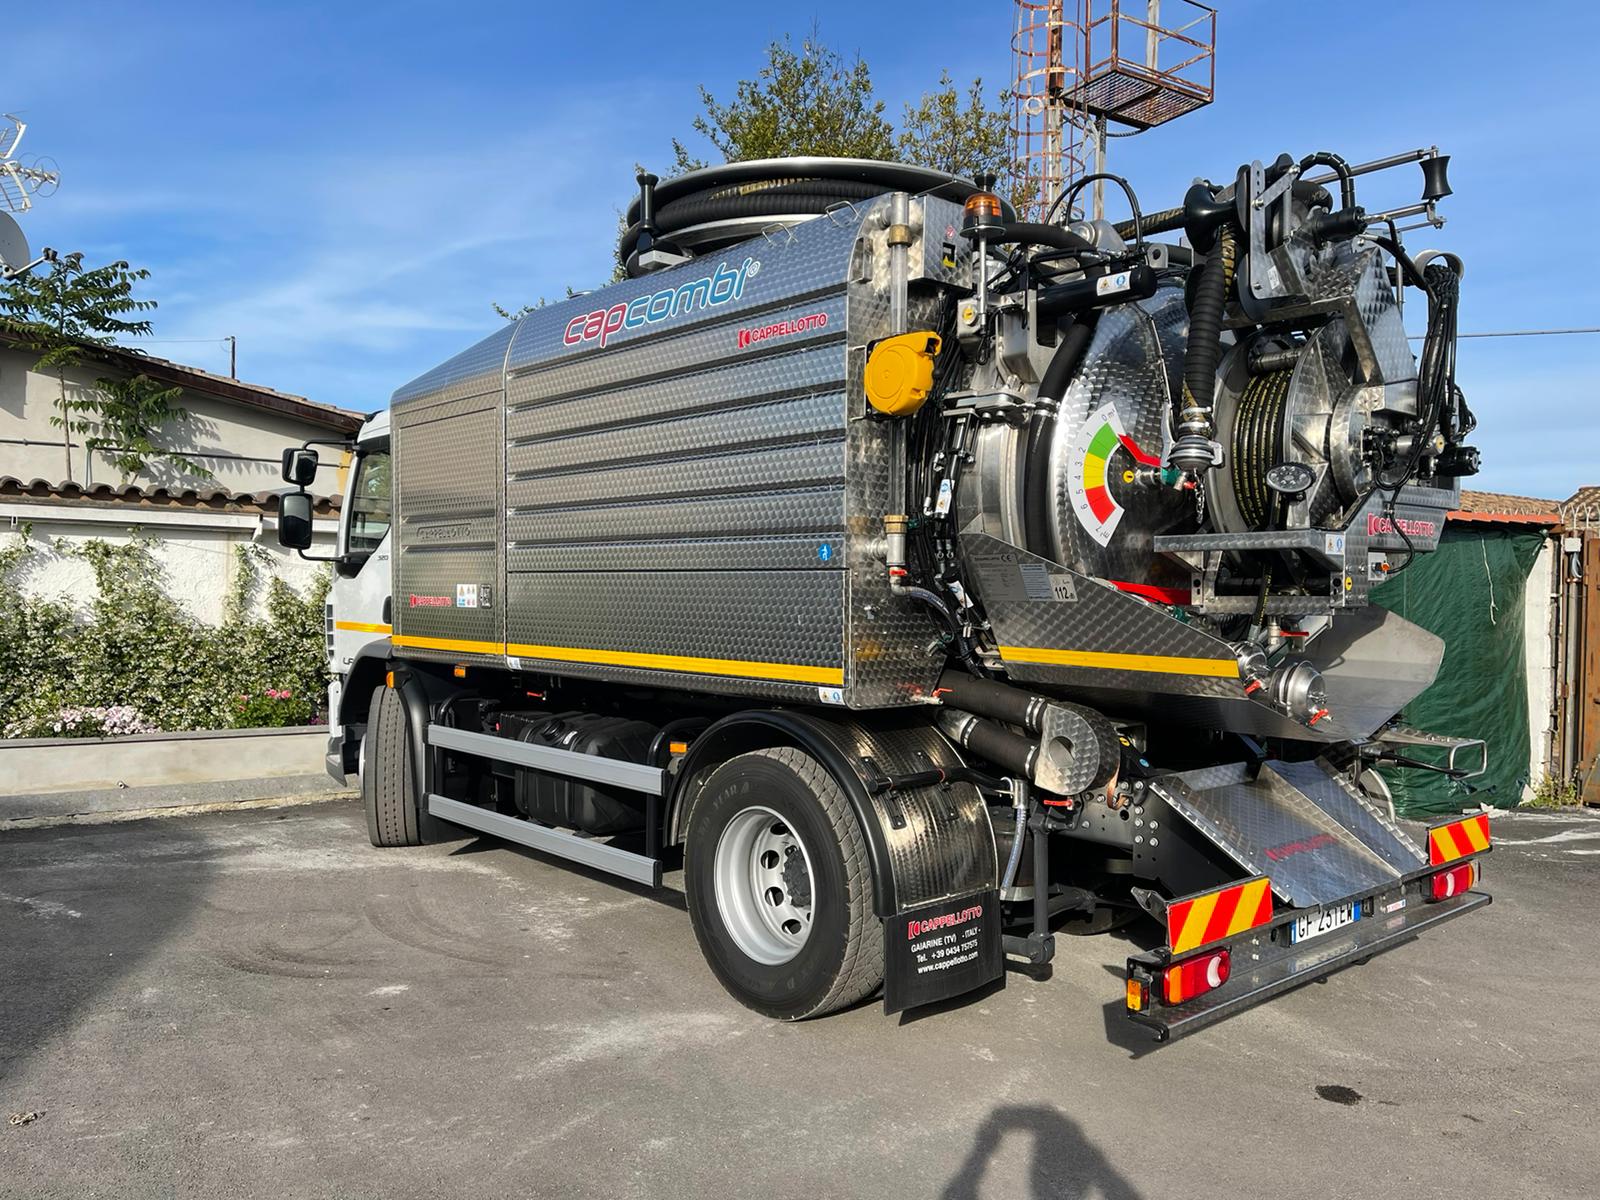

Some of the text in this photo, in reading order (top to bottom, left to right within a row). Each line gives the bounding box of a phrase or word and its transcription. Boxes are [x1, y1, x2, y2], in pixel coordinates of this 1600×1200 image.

[751, 313, 829, 343] CAPPELLOTTO
[1380, 517, 1434, 537] CAPELLOTTO
[1055, 586, 1070, 600] 112
[921, 905, 983, 933] CAPPELLOTTO
[1298, 914, 1312, 938] GF
[911, 937, 943, 953] GAIARINE
[944, 933, 957, 946] (TV)
[916, 938, 978, 963] Tel. +39 0434 757575
[917, 950, 979, 974] www.cappellotto.com
